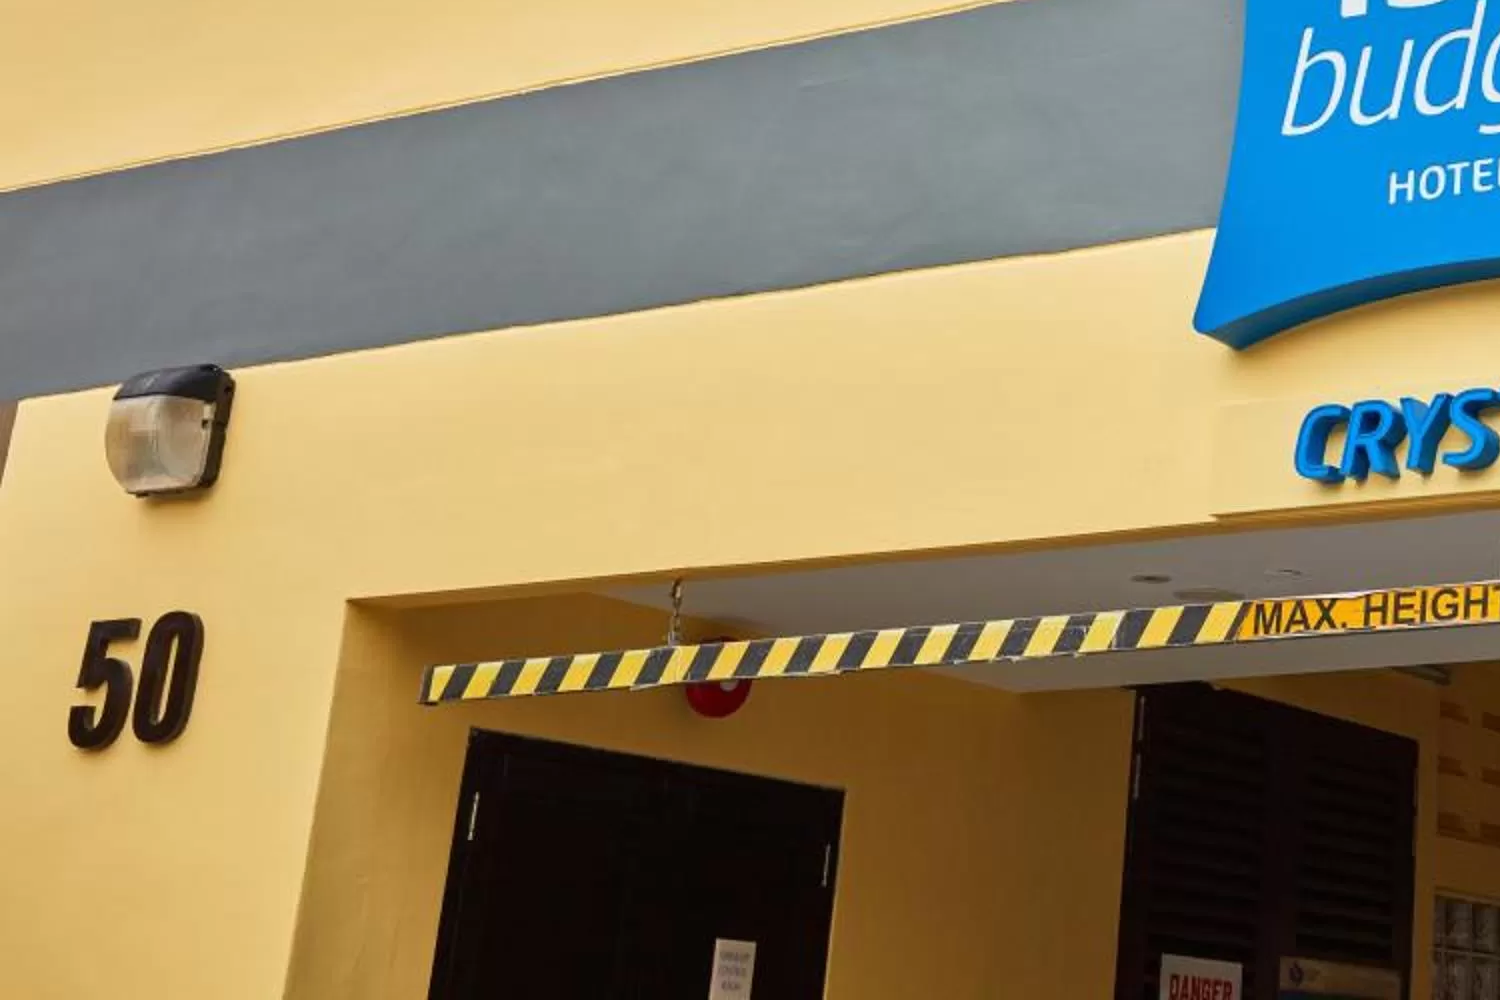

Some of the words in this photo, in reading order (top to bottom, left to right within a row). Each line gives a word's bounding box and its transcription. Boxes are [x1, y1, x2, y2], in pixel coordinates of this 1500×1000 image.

[1253, 597, 1348, 635] MAX.
[67, 610, 206, 750] 50
[1168, 972, 1234, 1000] DANGER
